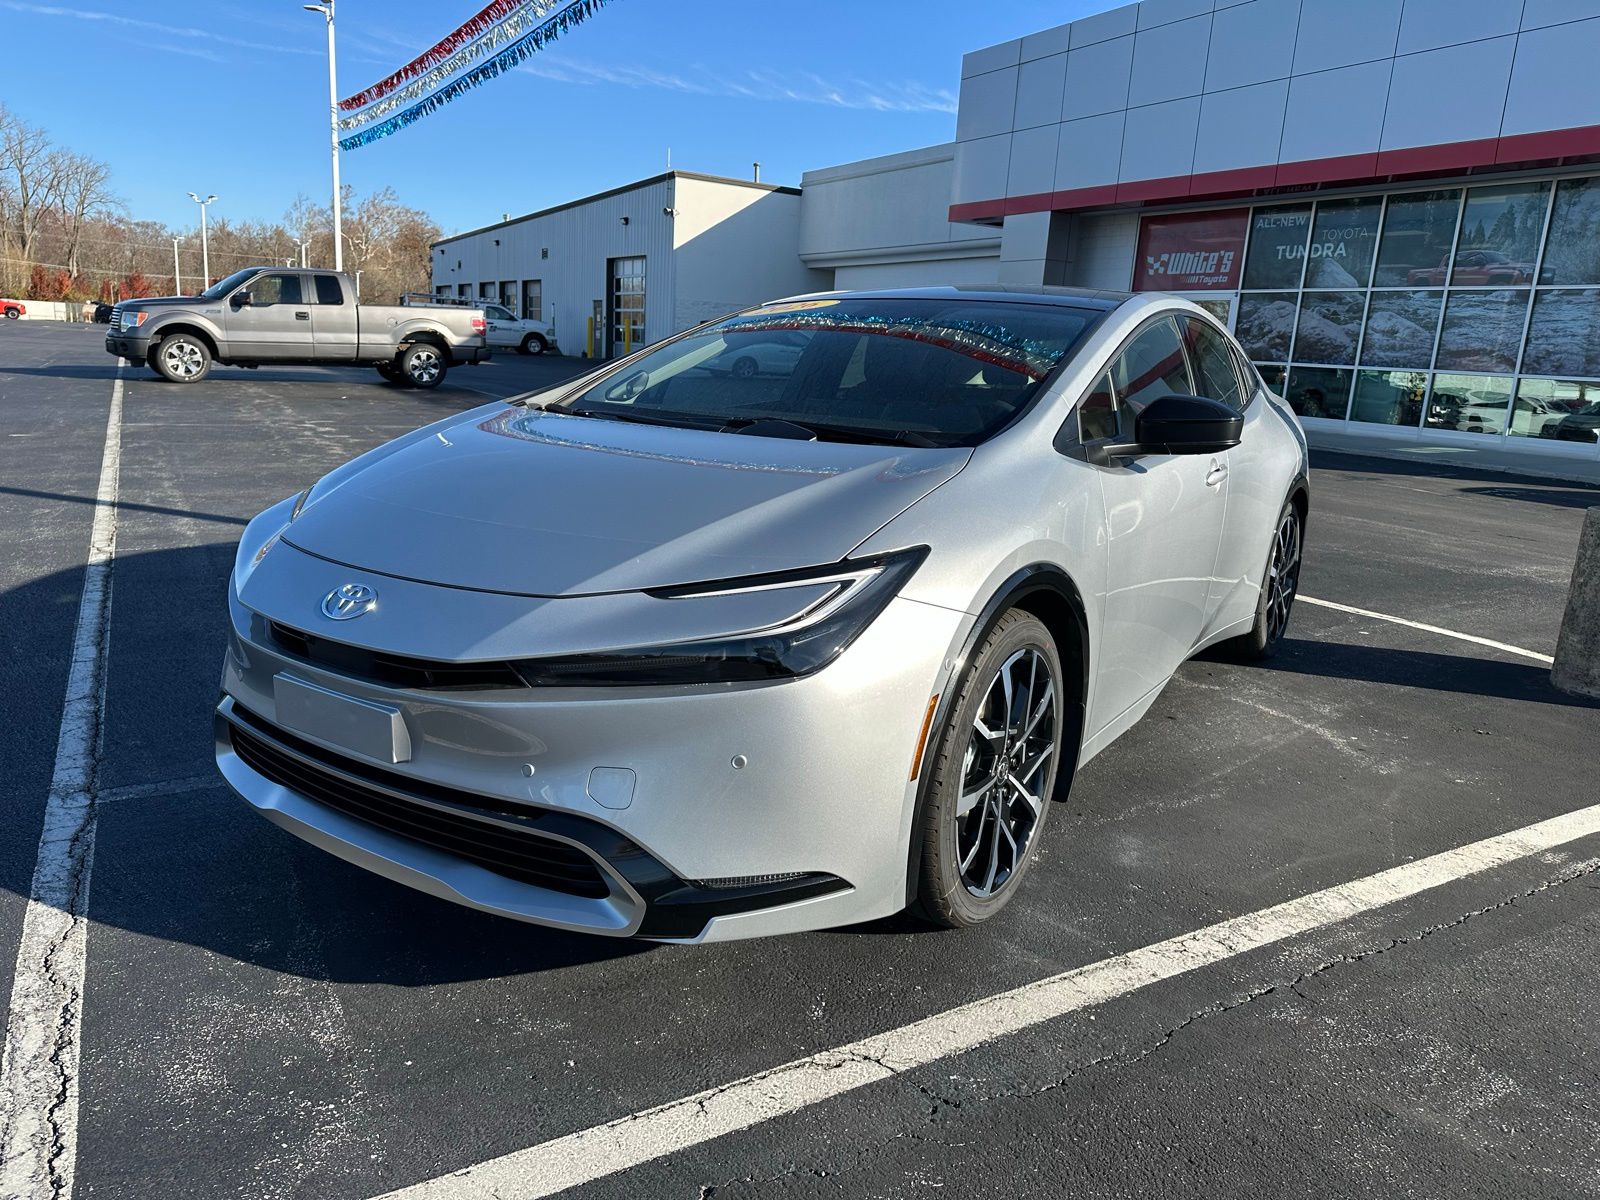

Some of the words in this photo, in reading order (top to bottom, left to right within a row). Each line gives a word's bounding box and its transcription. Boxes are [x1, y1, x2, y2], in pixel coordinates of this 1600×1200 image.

[1256, 215, 1307, 228] ALL-NEW
[1322, 227, 1368, 240] TOYOTA
[1276, 242, 1346, 260] TUNDRA
[1199, 275, 1229, 286] Toyota
